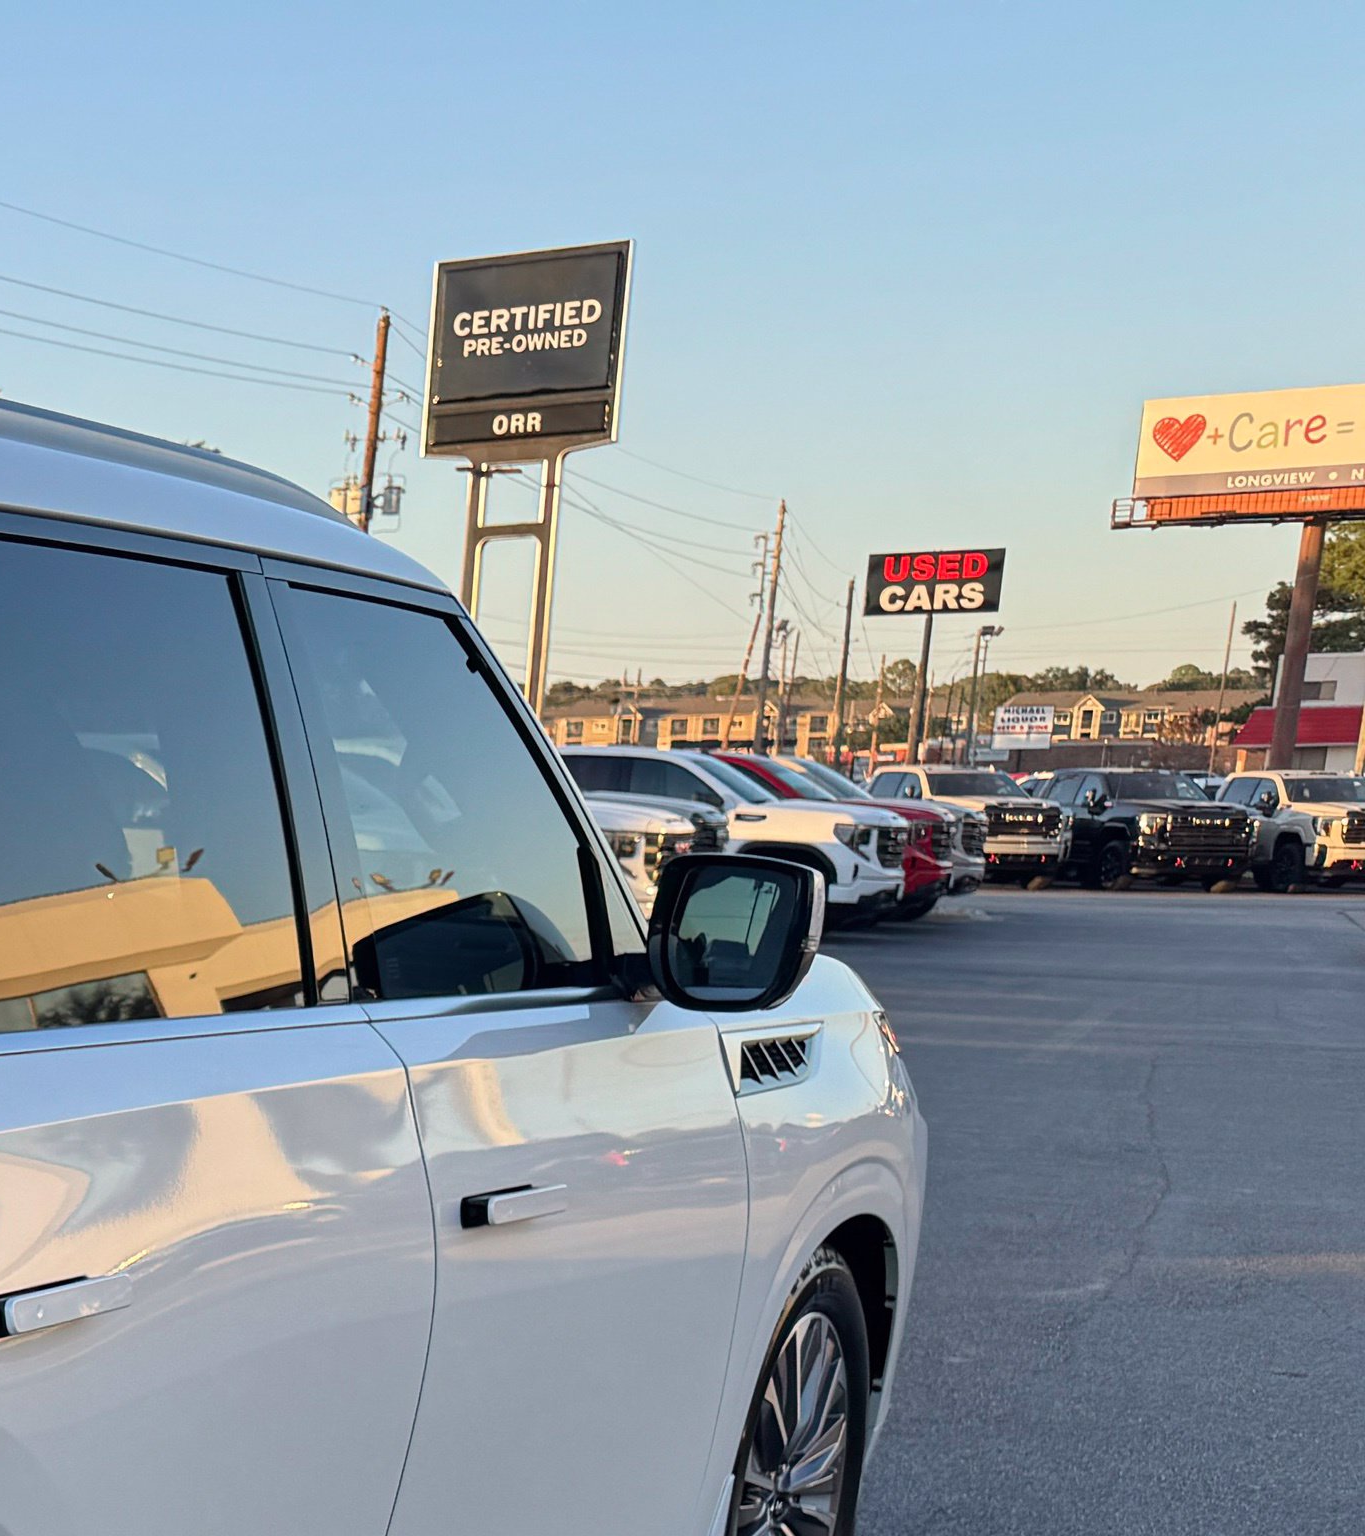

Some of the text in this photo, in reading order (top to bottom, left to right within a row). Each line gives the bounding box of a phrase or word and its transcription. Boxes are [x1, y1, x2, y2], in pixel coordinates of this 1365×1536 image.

[453, 299, 602, 337] CERTIFIED
[463, 328, 588, 357] PRE-OWNED
[492, 412, 542, 435] ORR
[1226, 471, 1315, 489] LONGVIEW
[883, 552, 989, 583] USED
[879, 582, 985, 612] CARS
